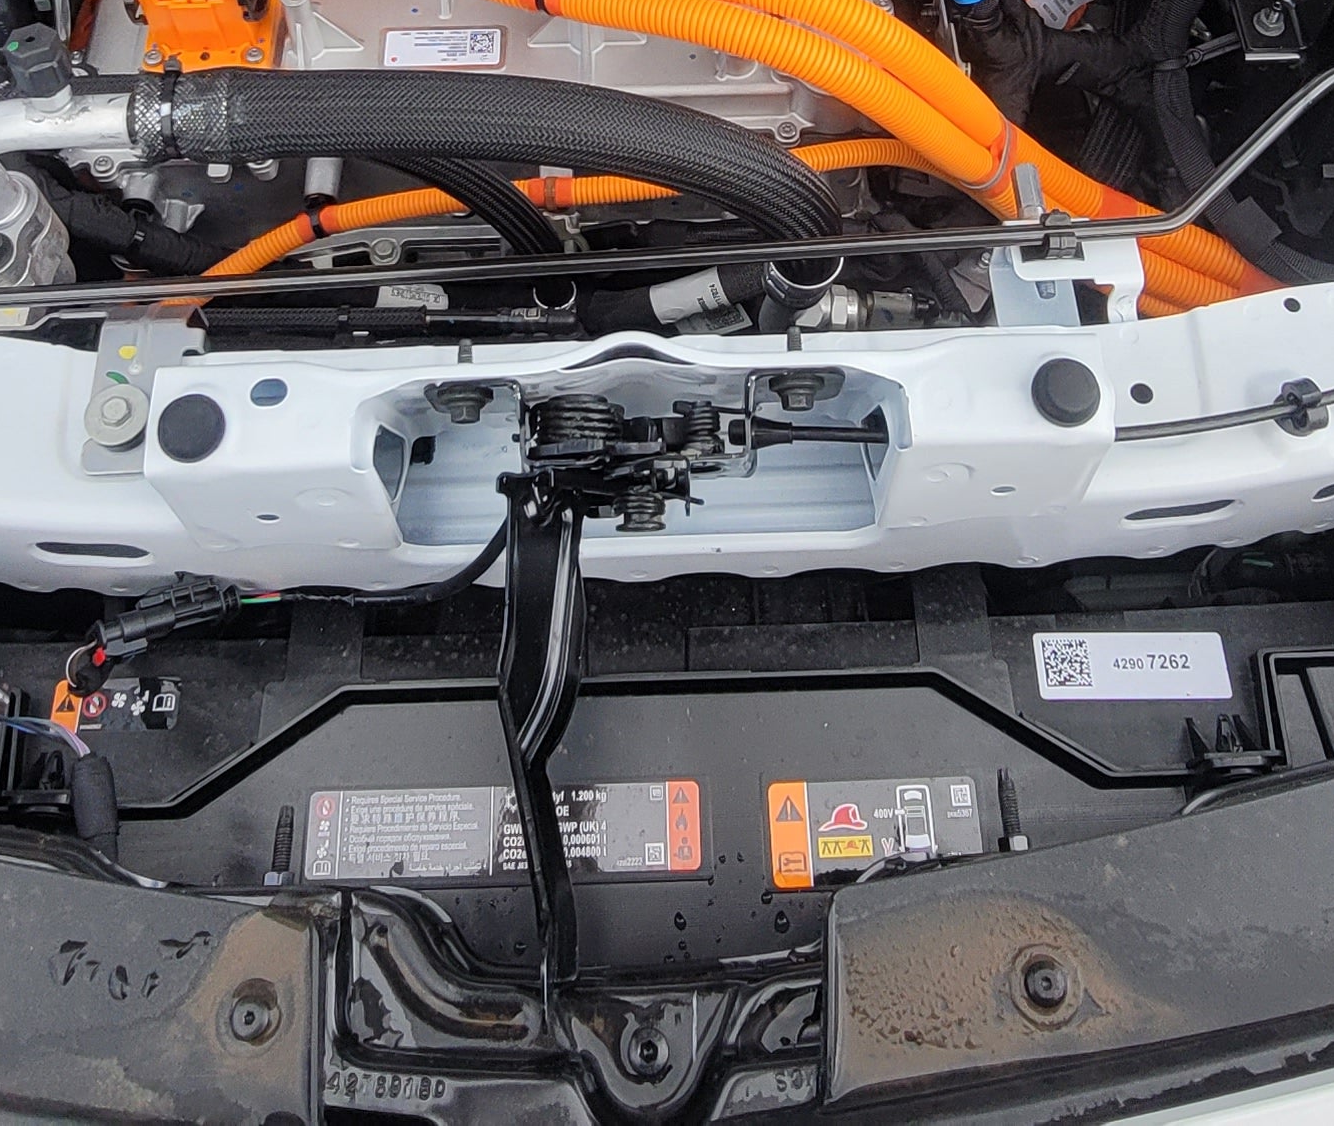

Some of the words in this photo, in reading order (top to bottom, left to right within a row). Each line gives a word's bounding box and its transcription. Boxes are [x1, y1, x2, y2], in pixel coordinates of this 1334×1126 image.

[1113, 658, 1144, 670] 4290
[1147, 654, 1191, 670] 7262
[380, 794, 403, 804] Special
[404, 794, 427, 803] Service
[571, 790, 594, 803] 1.200
[595, 790, 607, 803] kg
[873, 808, 894, 819] 400V
[579, 821, 599, 834] (UK)
[601, 821, 607, 832] 4
[503, 835, 525, 847] CO2
